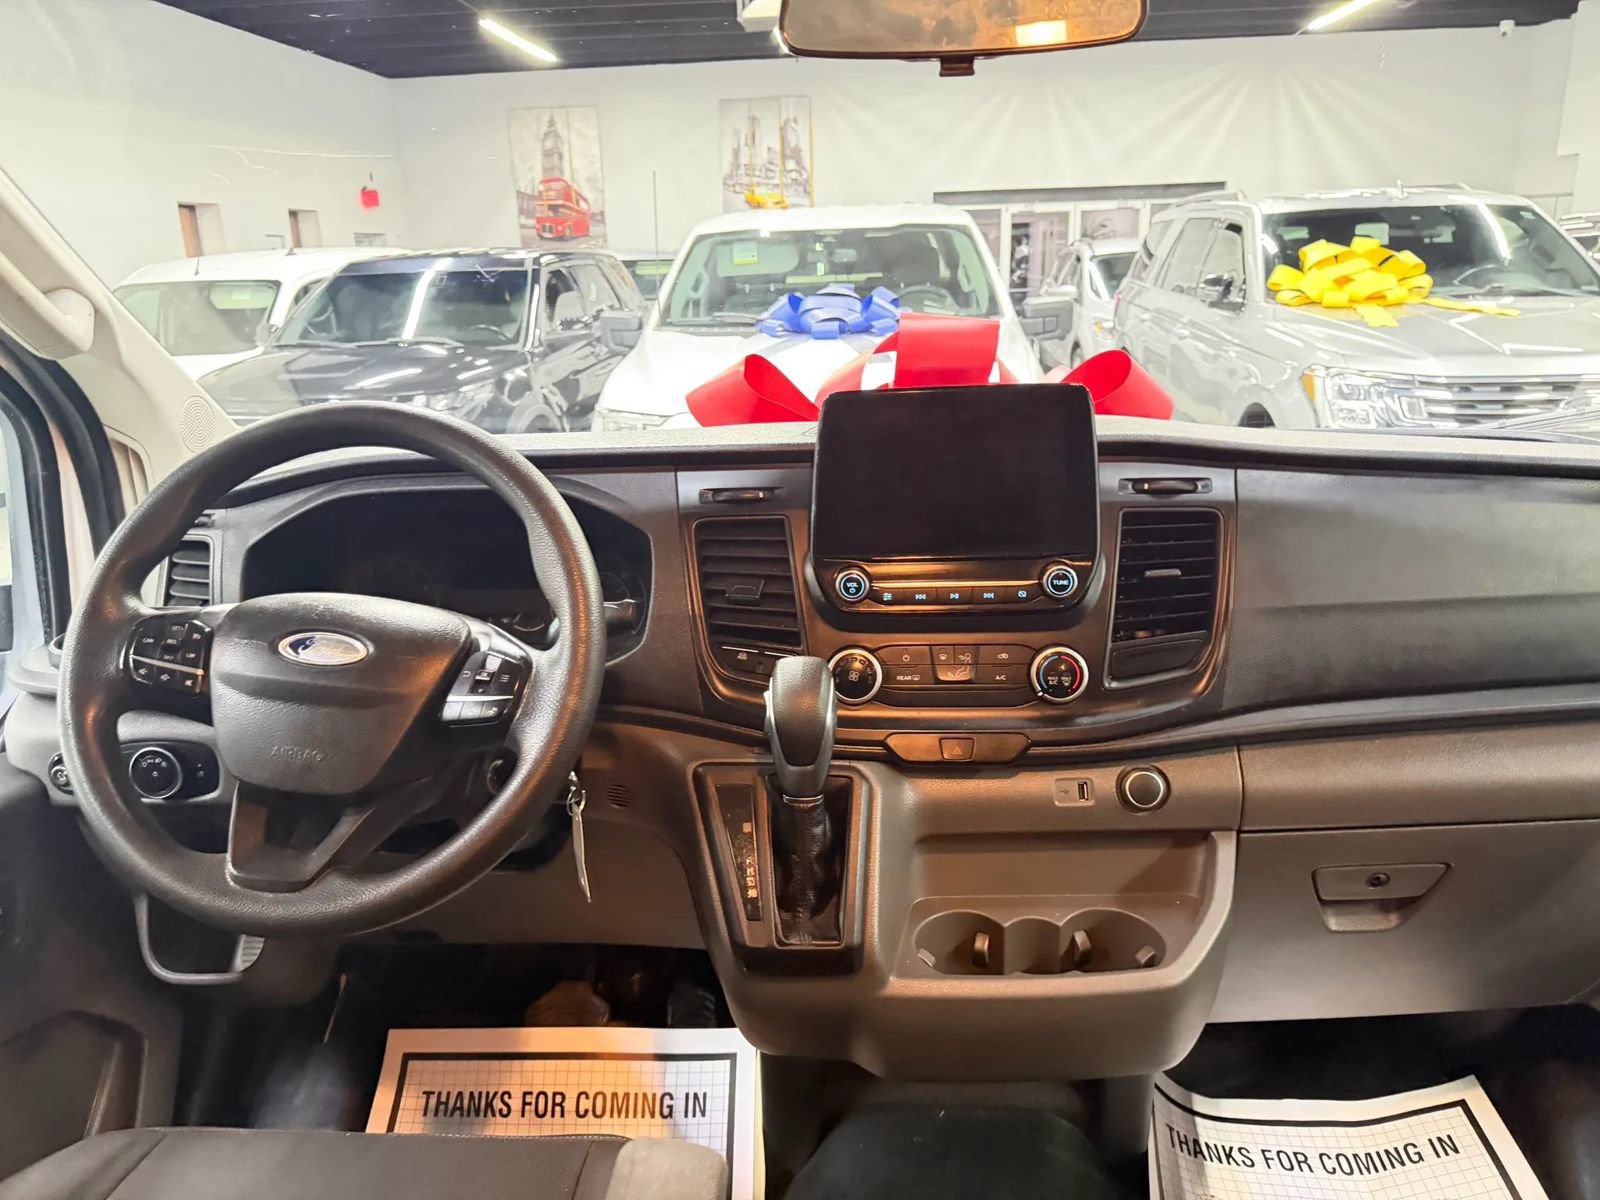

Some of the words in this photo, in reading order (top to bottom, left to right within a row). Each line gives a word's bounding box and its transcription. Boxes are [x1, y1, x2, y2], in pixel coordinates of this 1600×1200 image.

[422, 1090, 512, 1118] THANKS
[520, 1090, 566, 1119] FOR
[575, 1091, 675, 1119] COMING
[683, 1091, 707, 1118] IN
[1165, 1123, 1256, 1168] THANKS
[1260, 1148, 1314, 1174] FOR
[1318, 1142, 1425, 1176] COMING
[1427, 1134, 1461, 1159] IN
